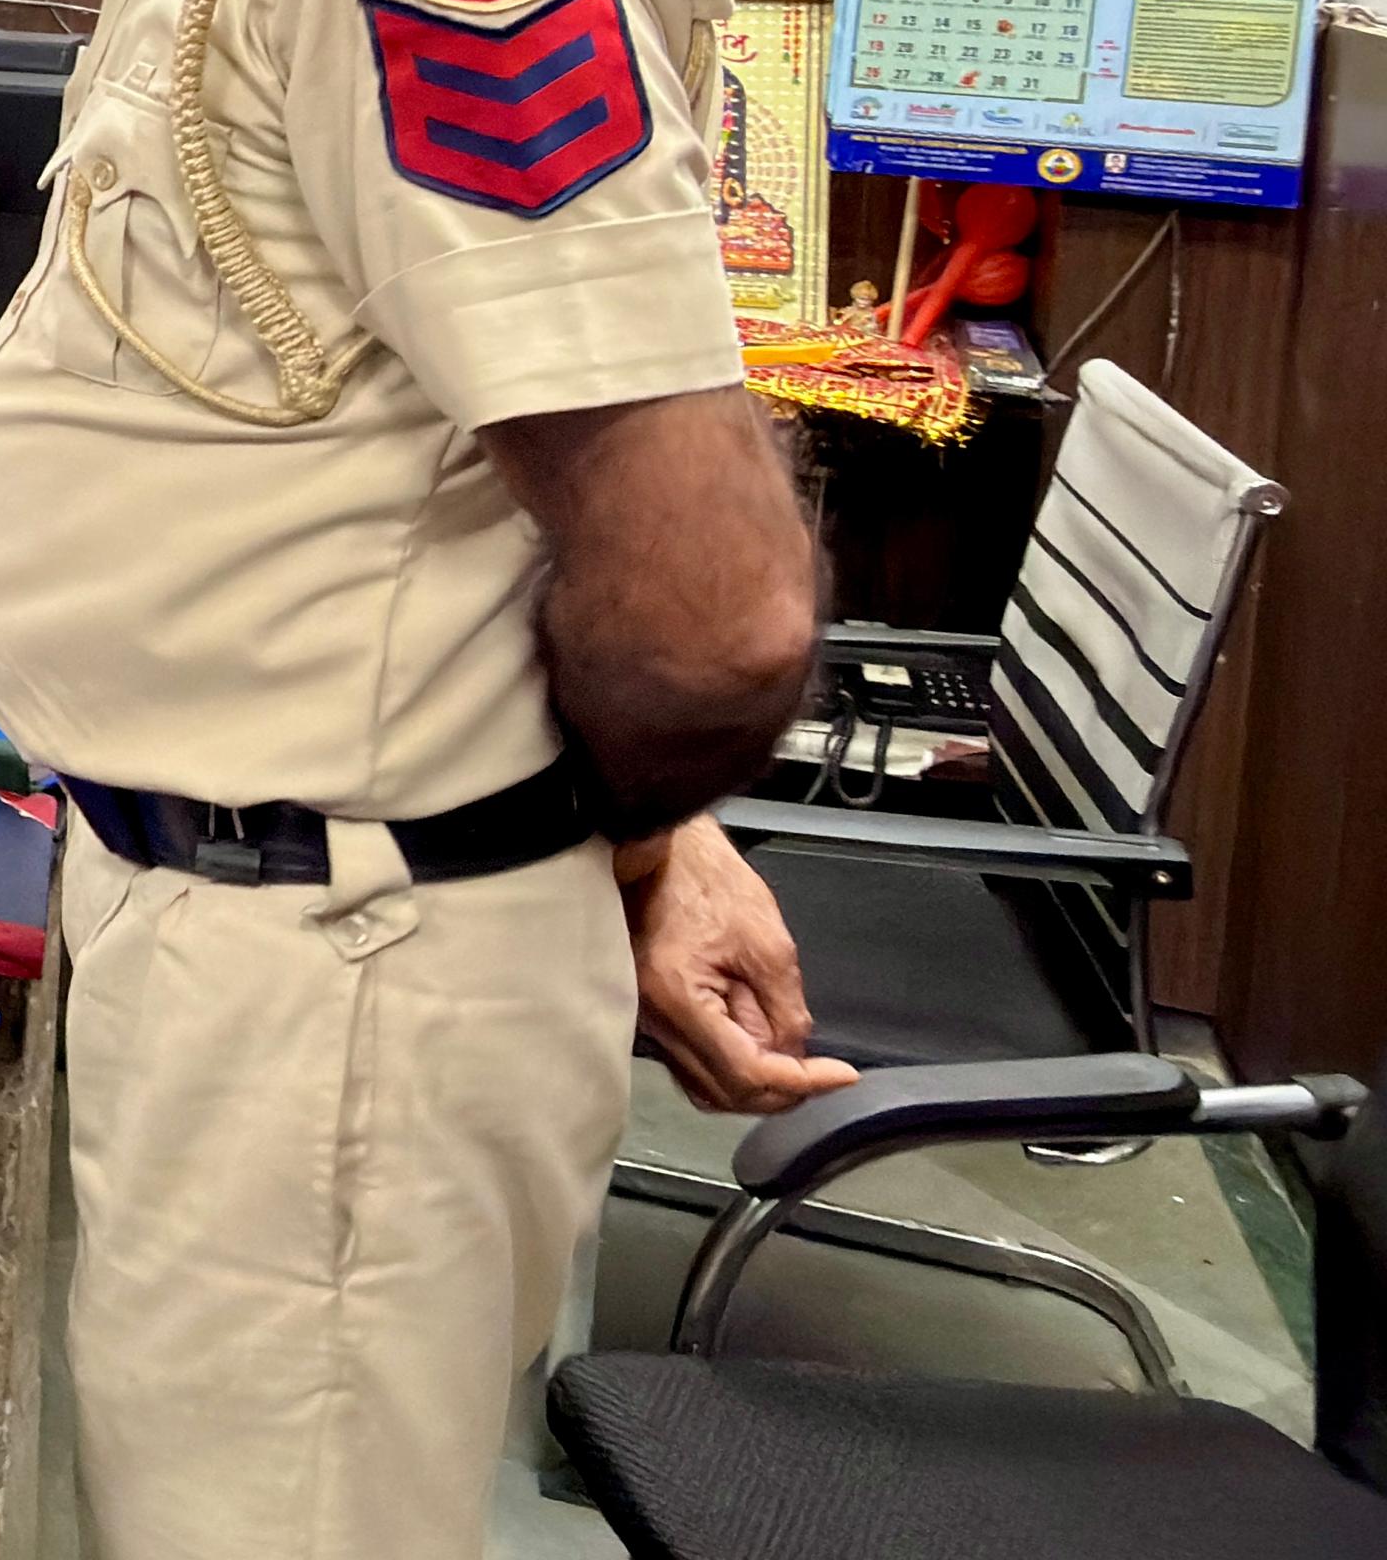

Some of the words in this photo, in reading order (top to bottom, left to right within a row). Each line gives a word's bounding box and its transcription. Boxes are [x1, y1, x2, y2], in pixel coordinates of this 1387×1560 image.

[901, 15, 918, 26] 13
[966, 19, 982, 31] 15
[1031, 22, 1047, 34] 17
[930, 44, 946, 56] 21
[994, 48, 1011, 60] 23
[1058, 52, 1075, 64] 25
